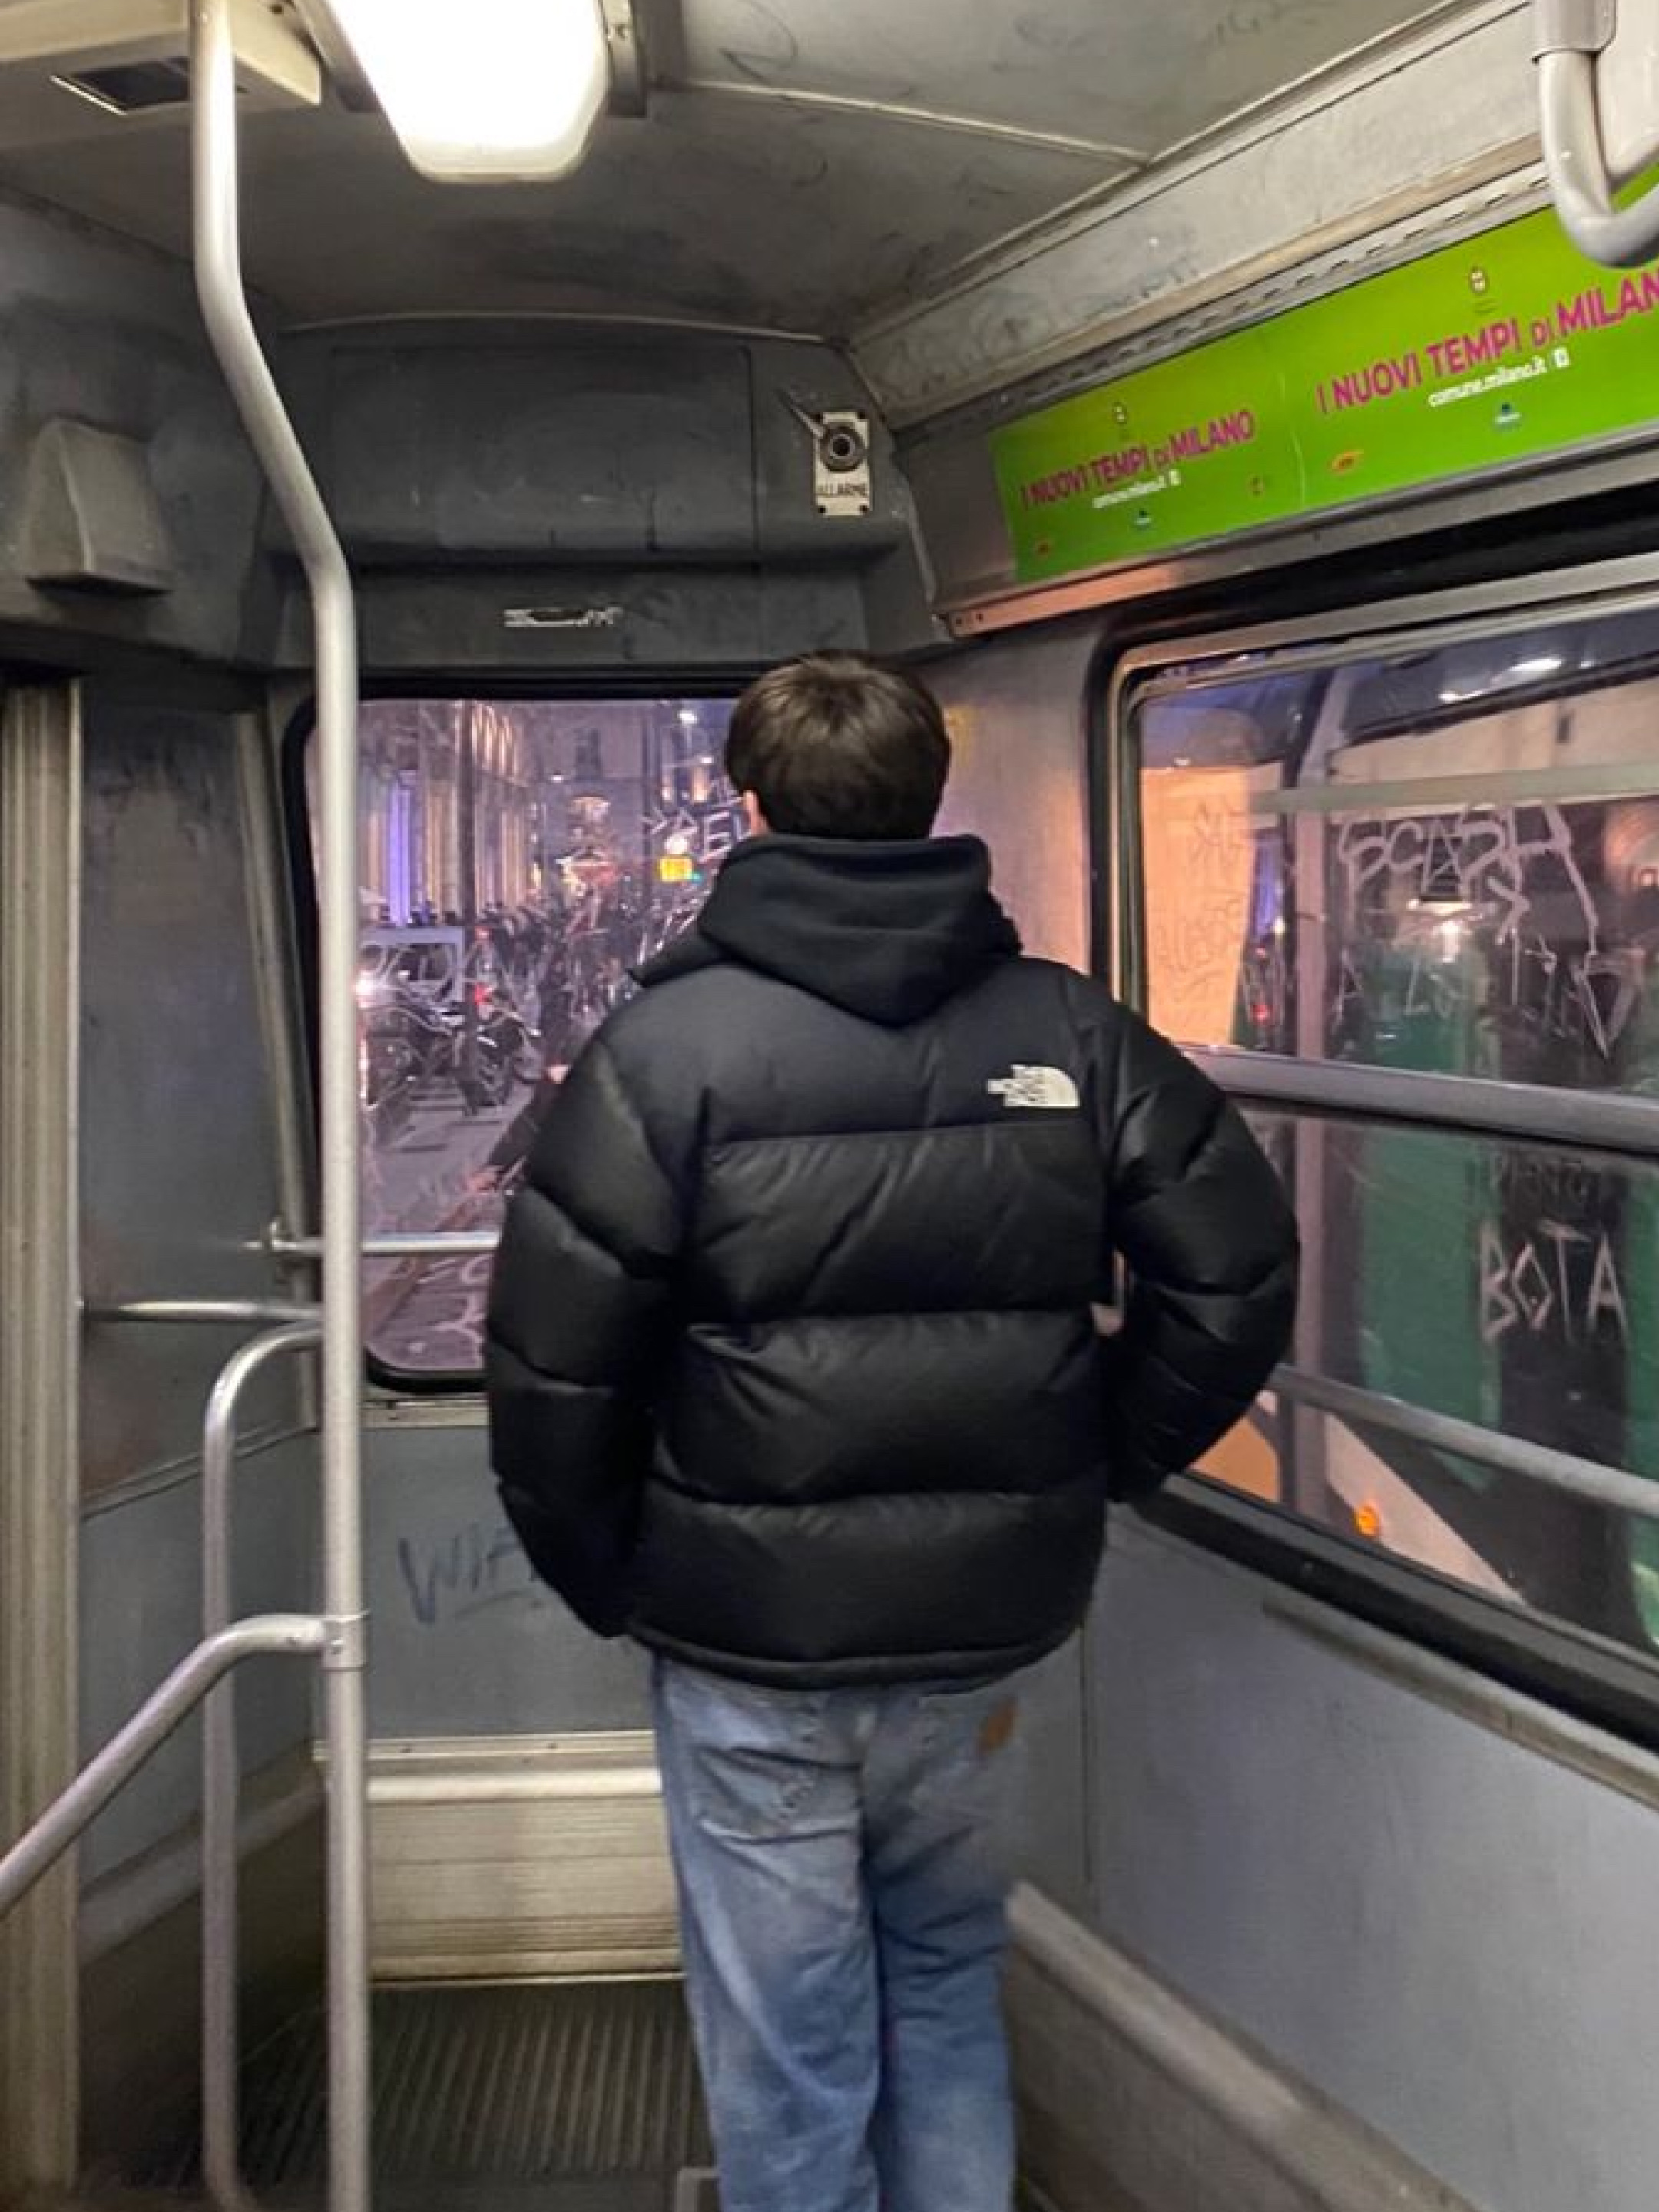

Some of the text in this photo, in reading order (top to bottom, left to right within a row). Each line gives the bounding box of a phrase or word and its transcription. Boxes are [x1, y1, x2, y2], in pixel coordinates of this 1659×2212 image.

[1316, 381, 1327, 414] I
[1331, 352, 1422, 412] NUOVI
[1426, 317, 1522, 378] TEMPI
[1029, 464, 1088, 505] NUOVI
[1089, 445, 1151, 487] TEMPI
[1169, 409, 1255, 461] MILANO
[1479, 1220, 1630, 1348] BOTA
